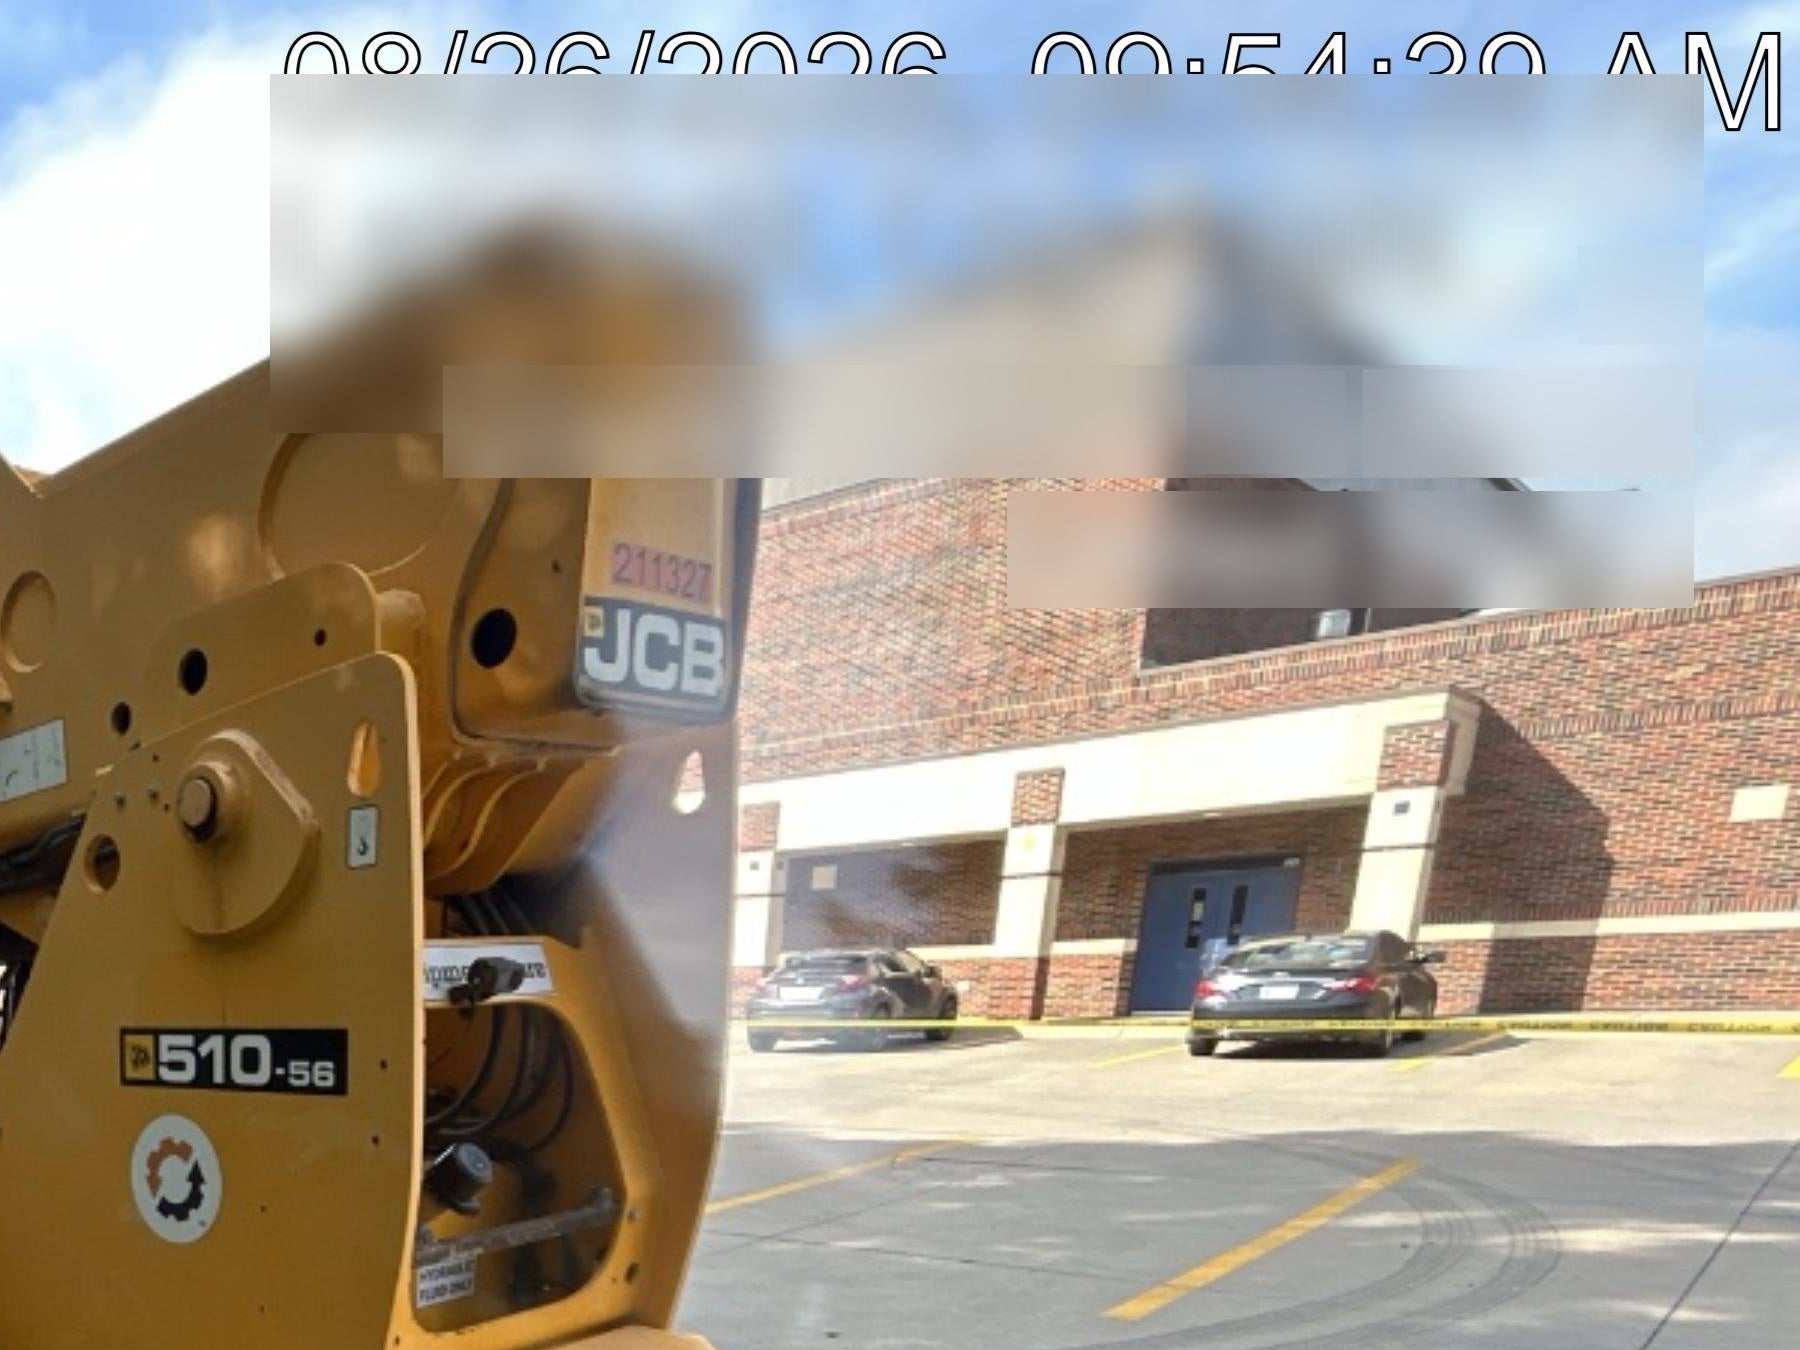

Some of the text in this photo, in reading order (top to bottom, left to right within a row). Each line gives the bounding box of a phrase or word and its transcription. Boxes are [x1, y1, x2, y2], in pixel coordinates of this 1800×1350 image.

[612, 542, 712, 602] 211327
[583, 607, 724, 697] JCB
[157, 1033, 336, 1088] 510-56
